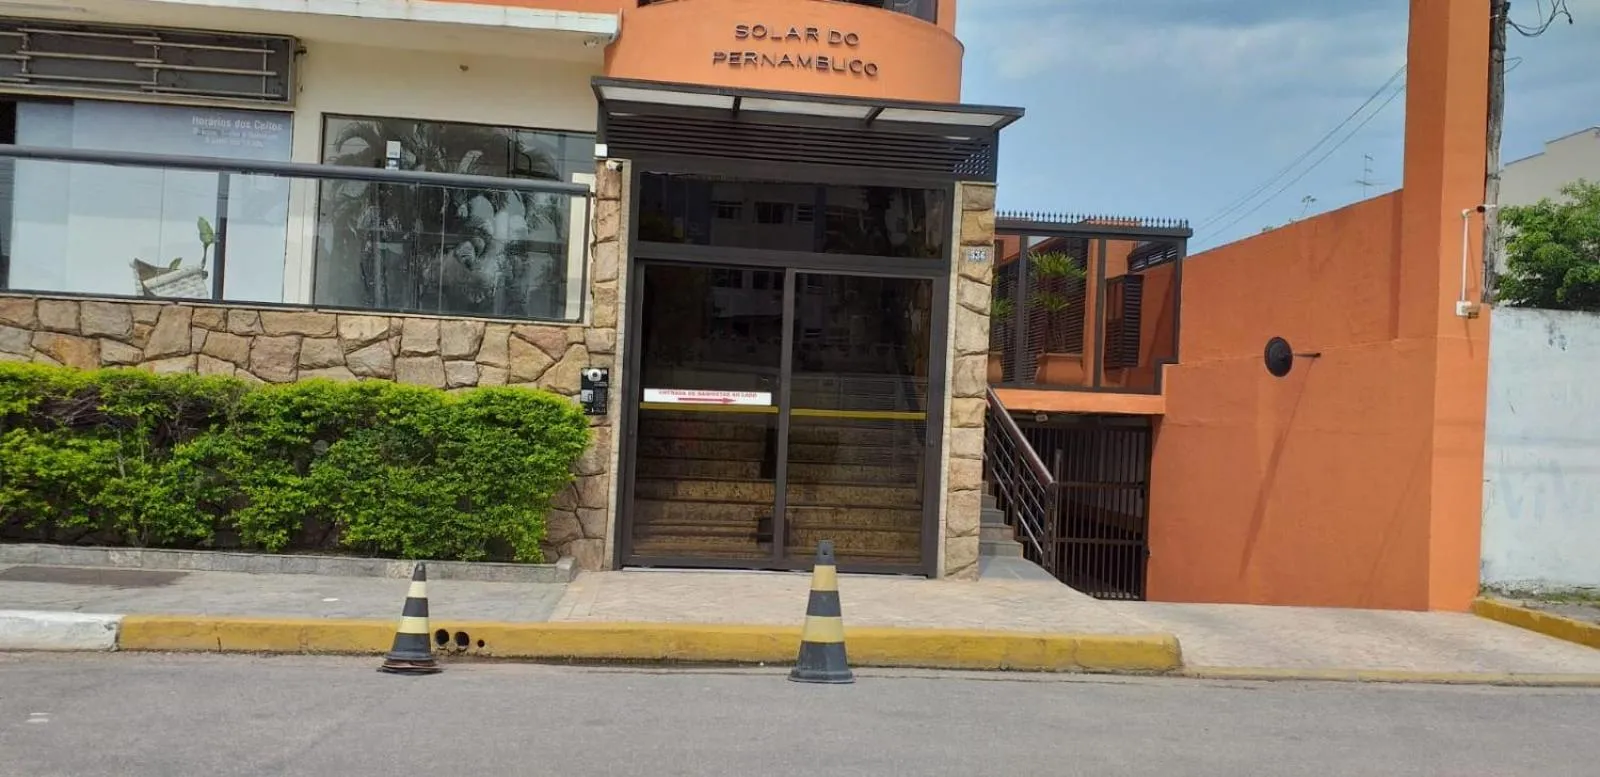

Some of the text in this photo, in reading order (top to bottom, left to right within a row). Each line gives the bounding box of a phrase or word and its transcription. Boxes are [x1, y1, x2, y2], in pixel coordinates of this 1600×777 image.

[735, 24, 860, 46] SOLAR DO
[712, 51, 879, 77] PERNAMBUCO
[234, 119, 252, 129] dos
